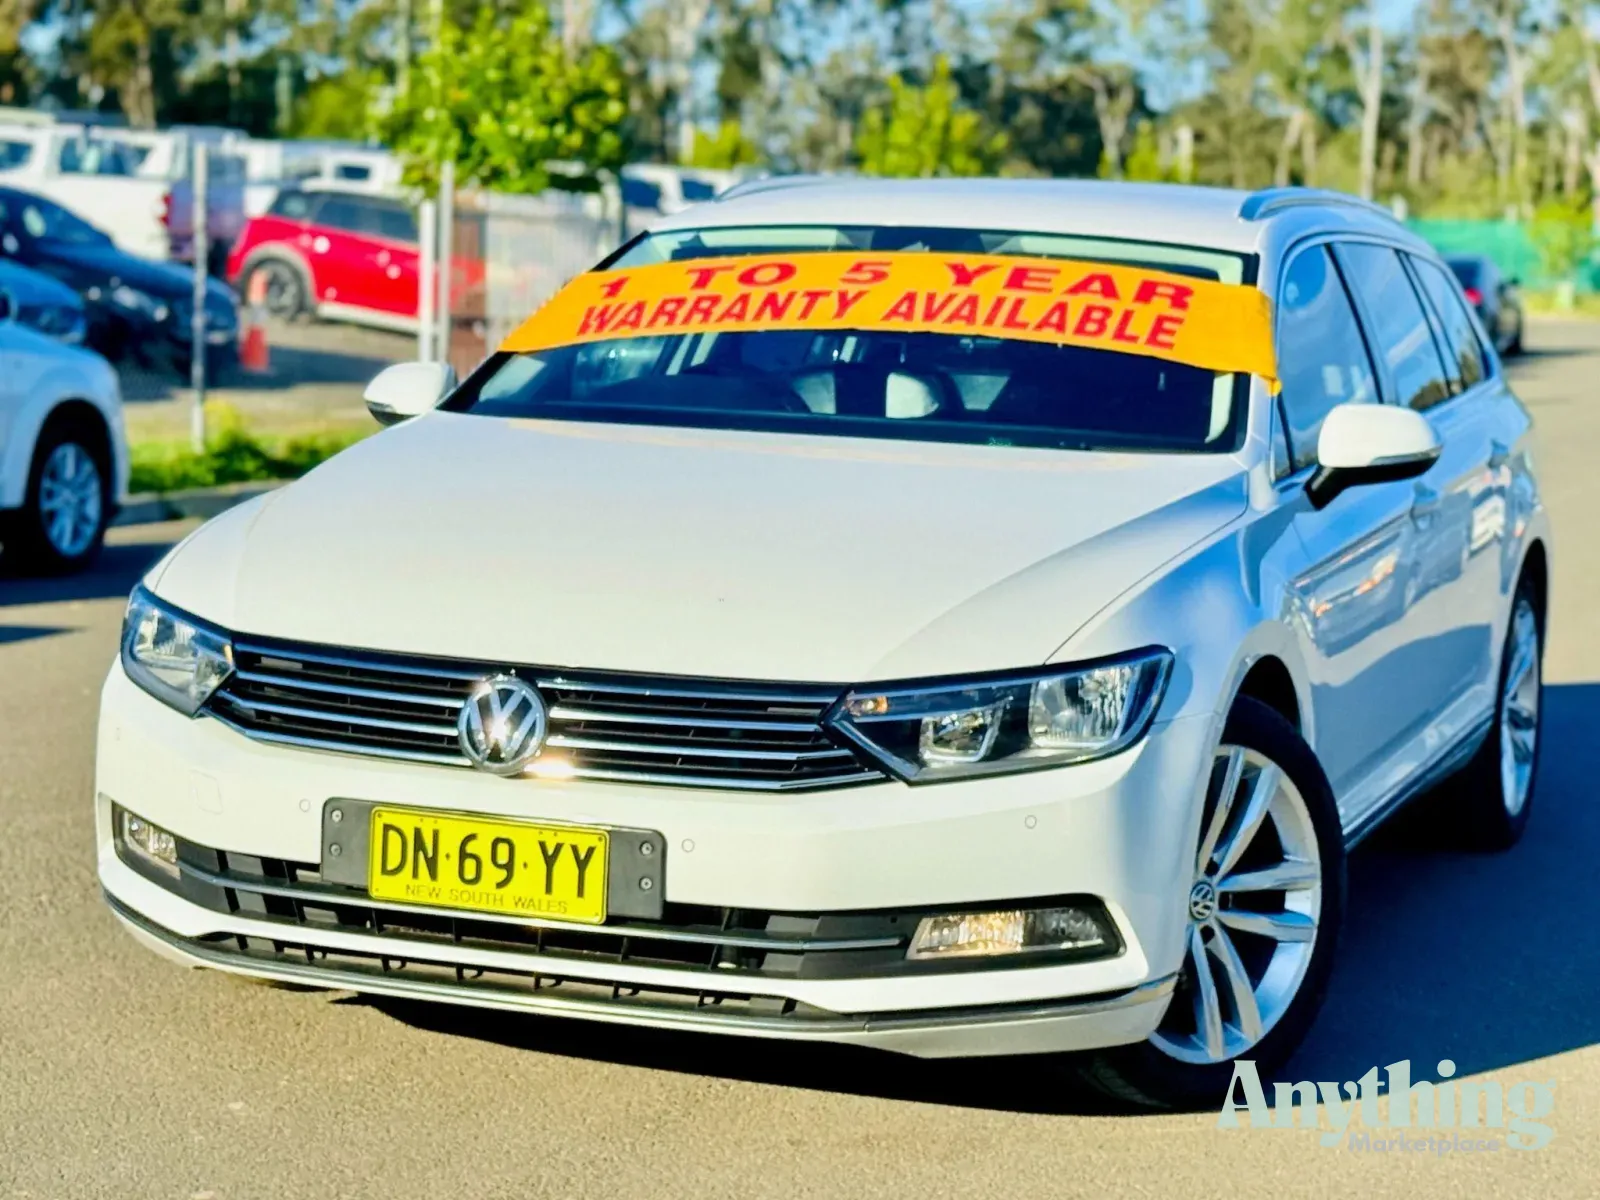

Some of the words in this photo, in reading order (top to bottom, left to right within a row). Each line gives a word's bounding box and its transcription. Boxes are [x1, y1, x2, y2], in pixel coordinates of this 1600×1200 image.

[599, 277, 627, 298] 1
[687, 263, 797, 289] TO
[839, 261, 890, 283] 5
[946, 263, 1194, 310] YEAR
[576, 289, 867, 336] WARRANTY
[882, 289, 1186, 351] AVAILABLE
[406, 882, 442, 898] NEW
[448, 888, 504, 907] SOUTH
[513, 894, 568, 914] WALES
